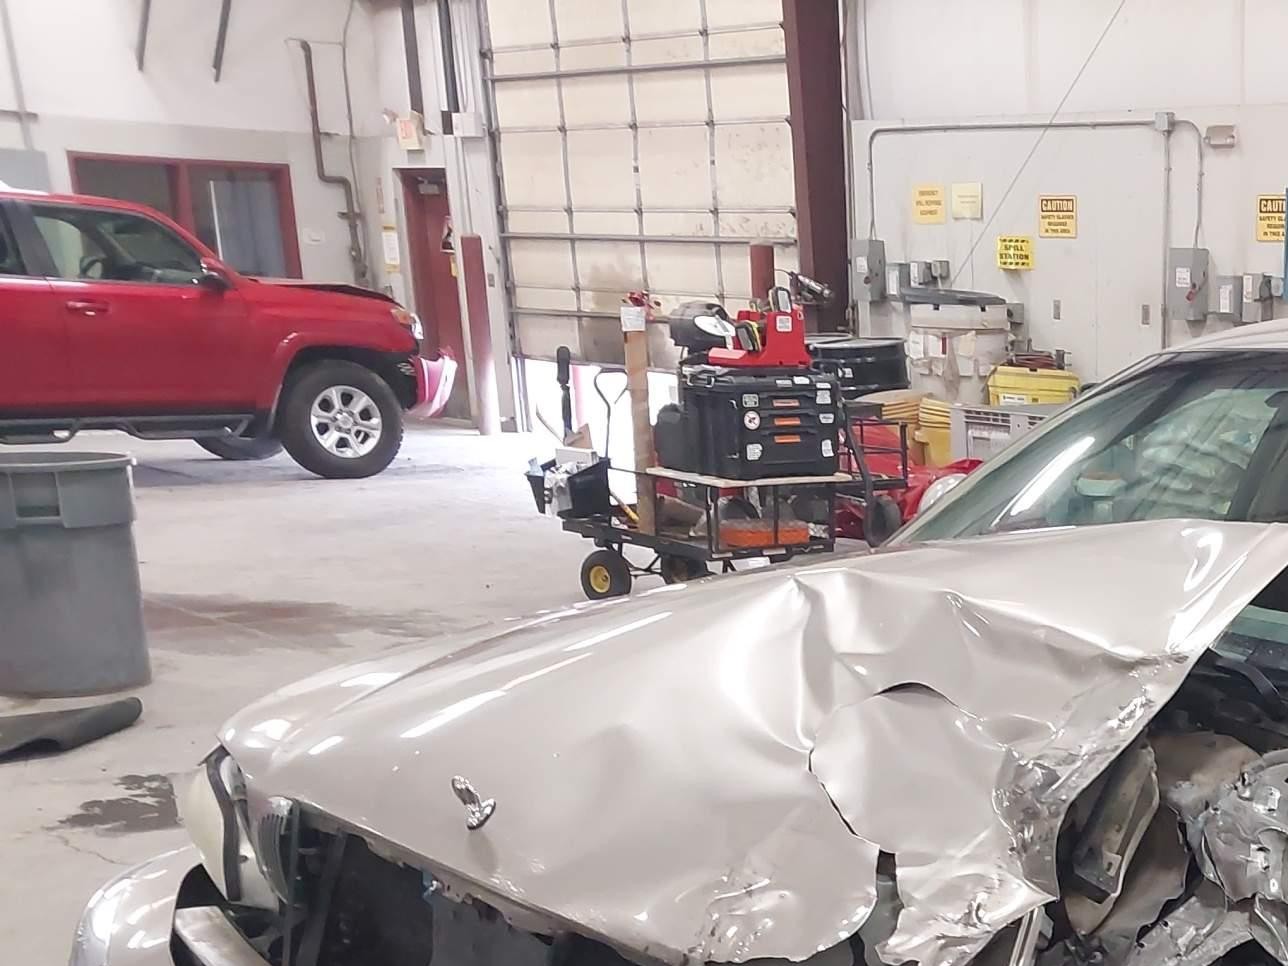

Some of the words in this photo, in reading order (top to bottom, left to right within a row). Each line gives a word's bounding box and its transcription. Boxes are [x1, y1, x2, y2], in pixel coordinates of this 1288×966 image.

[1042, 200, 1073, 211] CAUTION
[1261, 200, 1286, 212] CAUTI
[1004, 244, 1025, 252] SPILL
[999, 253, 1029, 261] STATION
